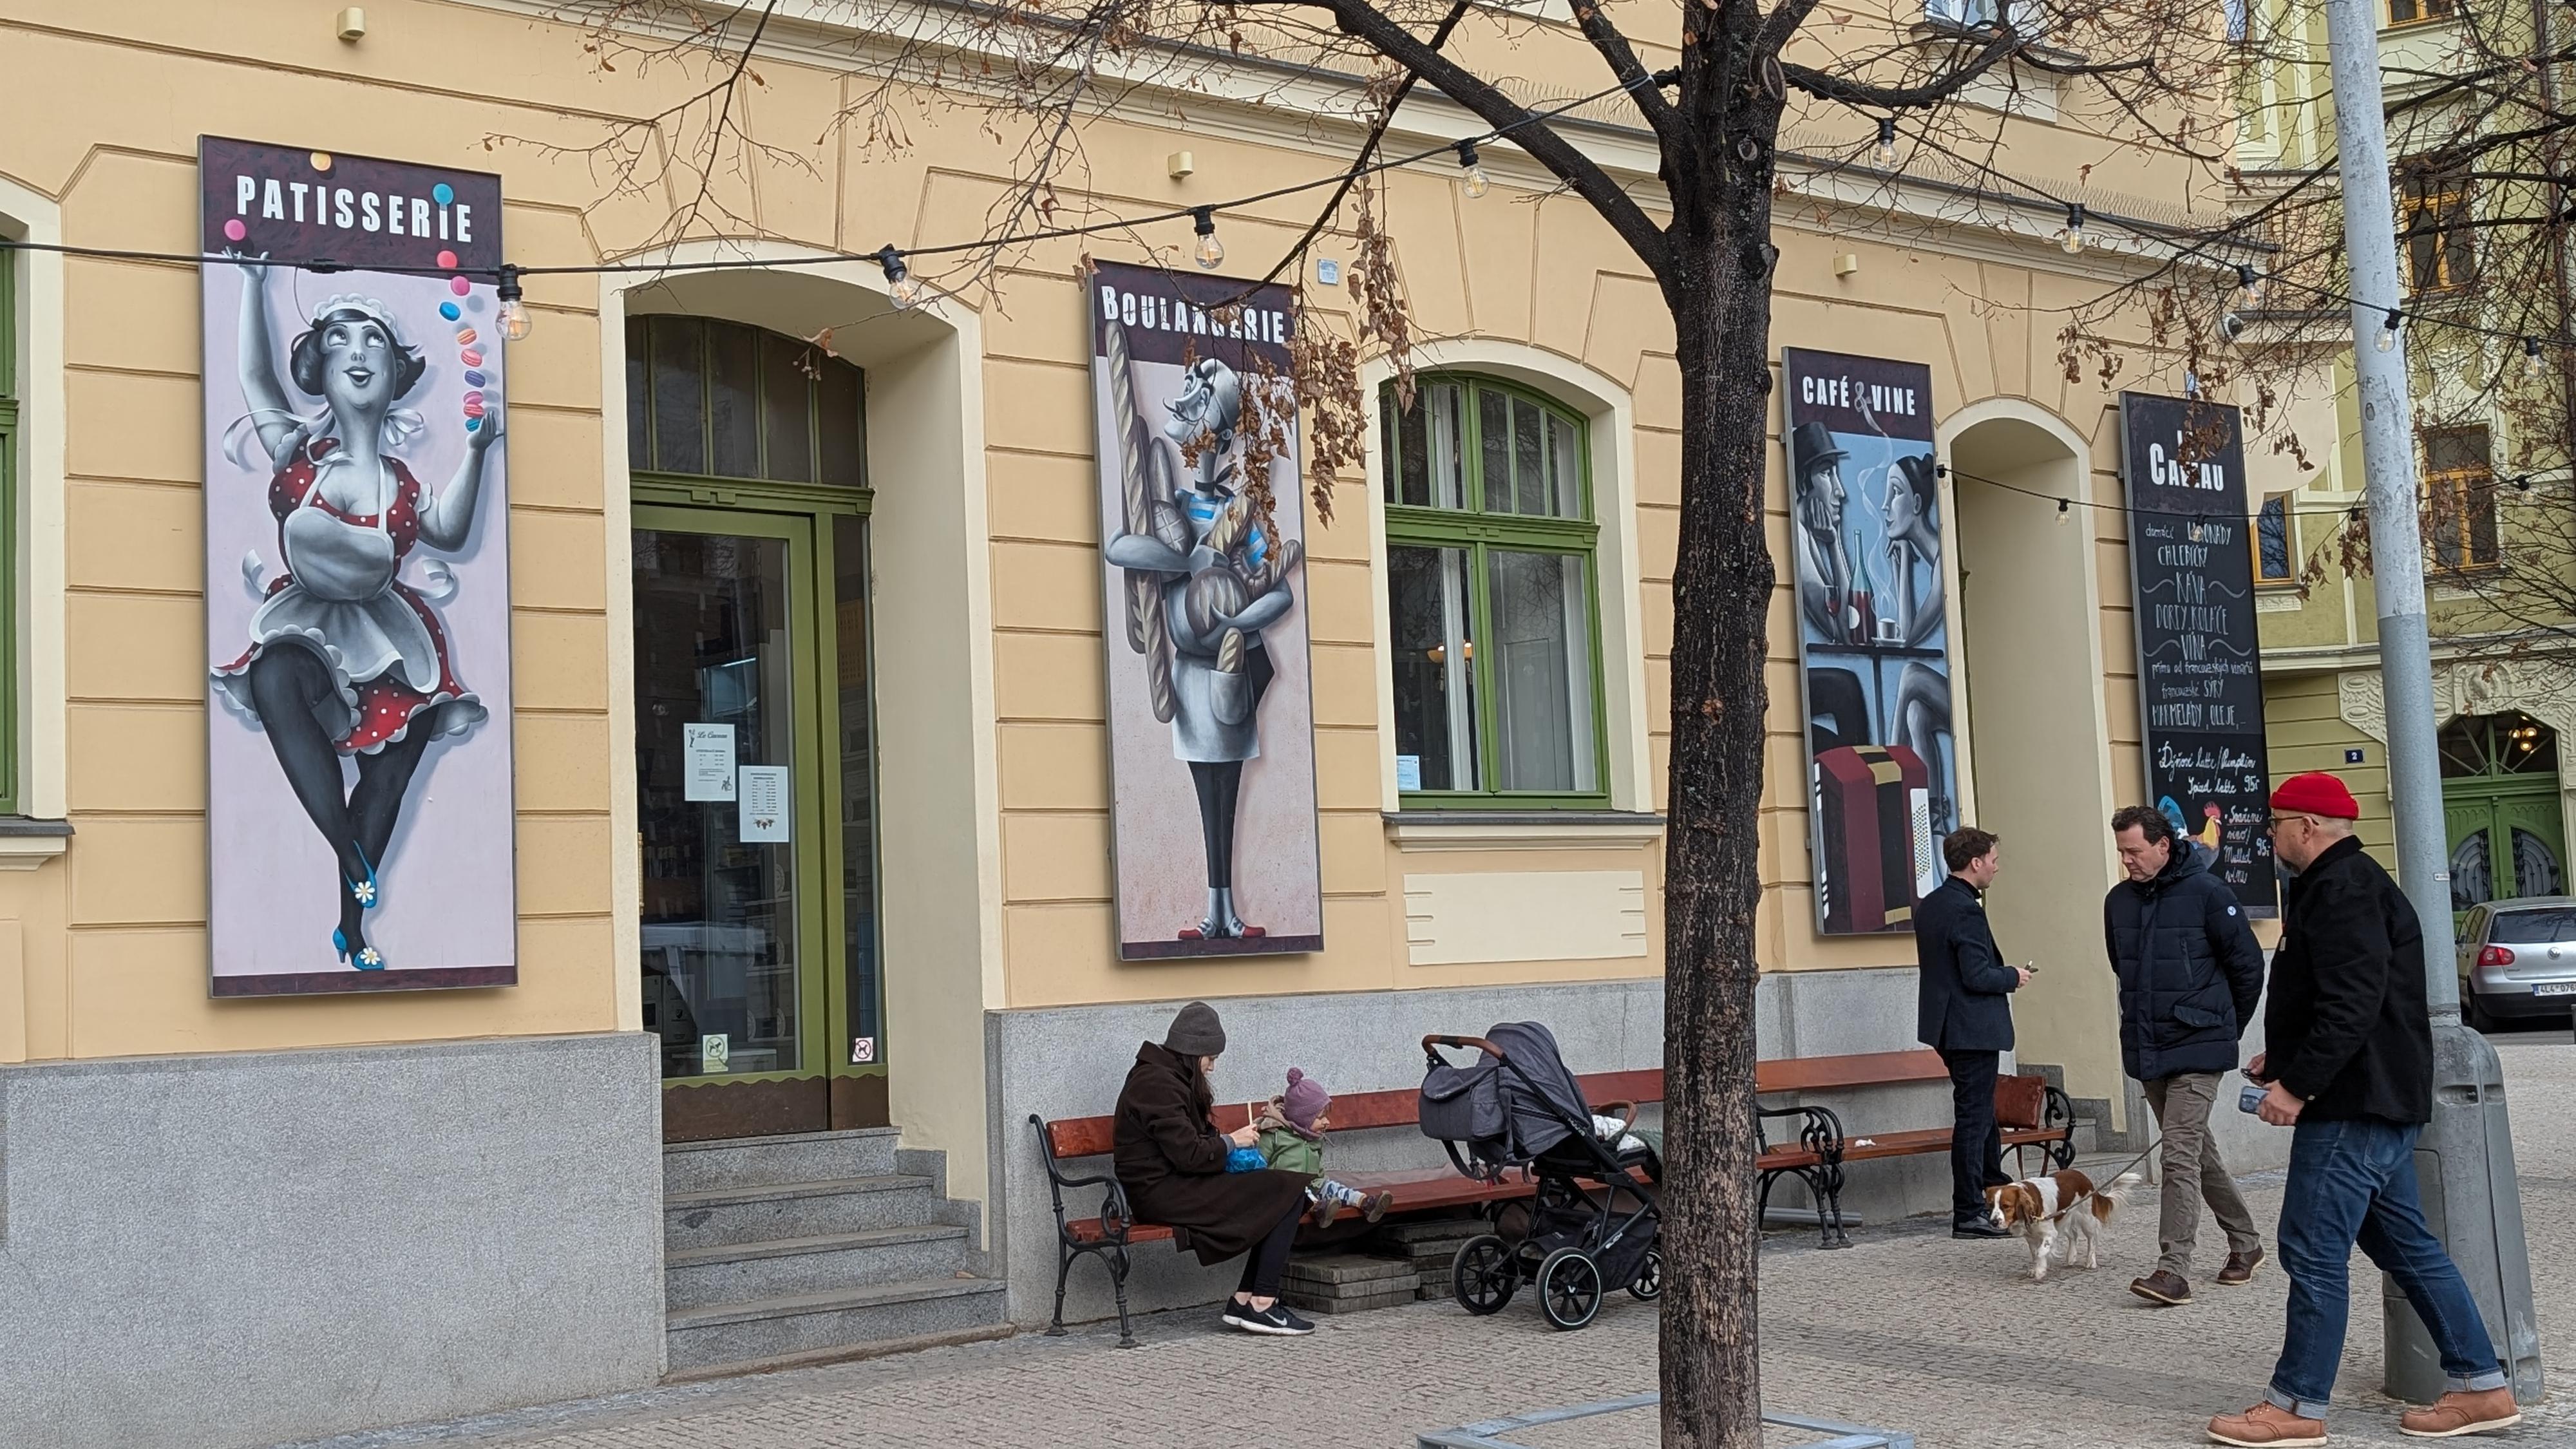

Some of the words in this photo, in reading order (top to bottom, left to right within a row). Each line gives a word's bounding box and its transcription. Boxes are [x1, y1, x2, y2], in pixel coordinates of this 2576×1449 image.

[236, 175, 471, 243] PATISSERIE
[1101, 285, 1285, 343] BOULANGERIE
[1803, 375, 1850, 408] CAFÉ
[1871, 384, 1915, 415] VINE
[2176, 571, 2208, 604] KÁVA
[2181, 631, 2208, 661] VÍNA
[2174, 660, 2183, 675] od
[2351, 752, 2358, 761] 2
[2540, 985, 2555, 994] 4L4
[2560, 983, 2576, 992] 076
